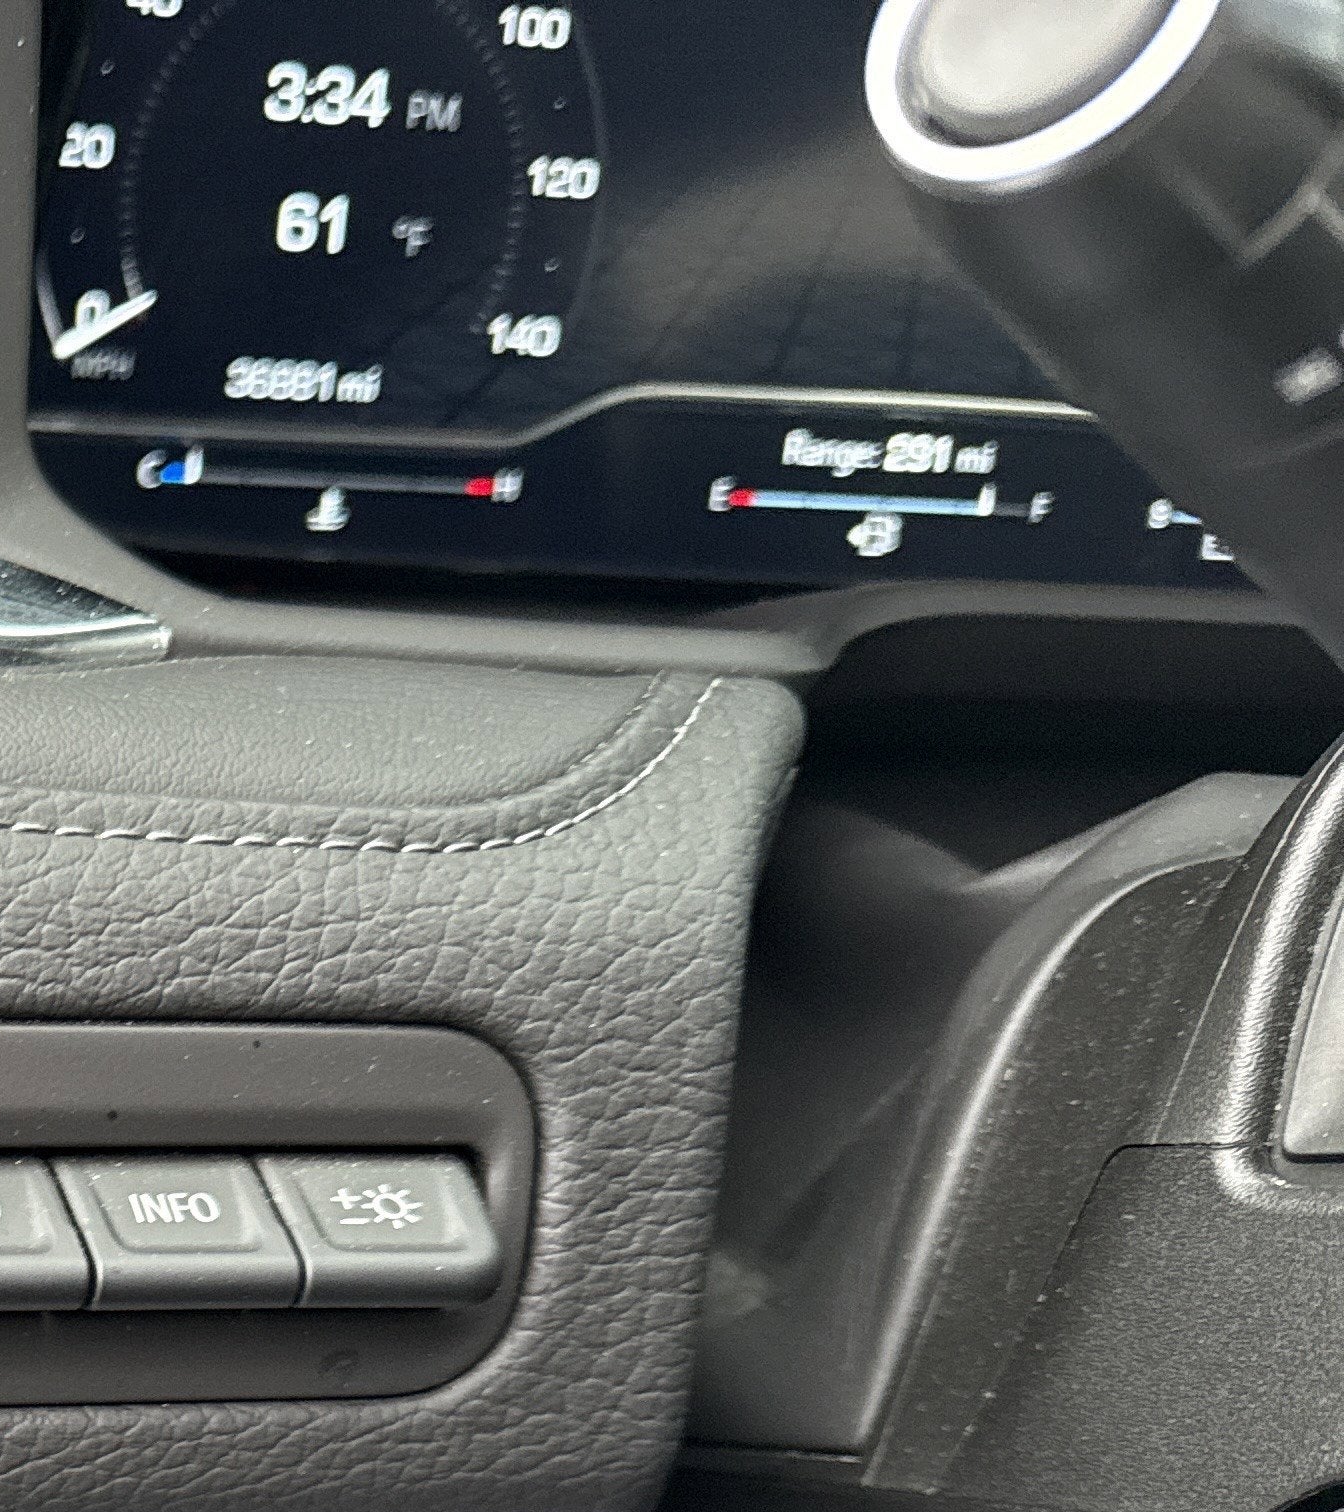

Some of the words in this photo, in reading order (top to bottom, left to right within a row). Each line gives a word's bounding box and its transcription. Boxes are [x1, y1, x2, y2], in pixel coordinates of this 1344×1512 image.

[499, 6, 572, 50] 100
[263, 61, 392, 129] 3:34
[405, 89, 463, 133] PM
[58, 122, 116, 170] 20
[526, 155, 601, 201] 120
[275, 191, 350, 255] 61
[486, 313, 563, 358] 140
[336, 362, 384, 404] mi
[127, 1191, 221, 1225] INFO
